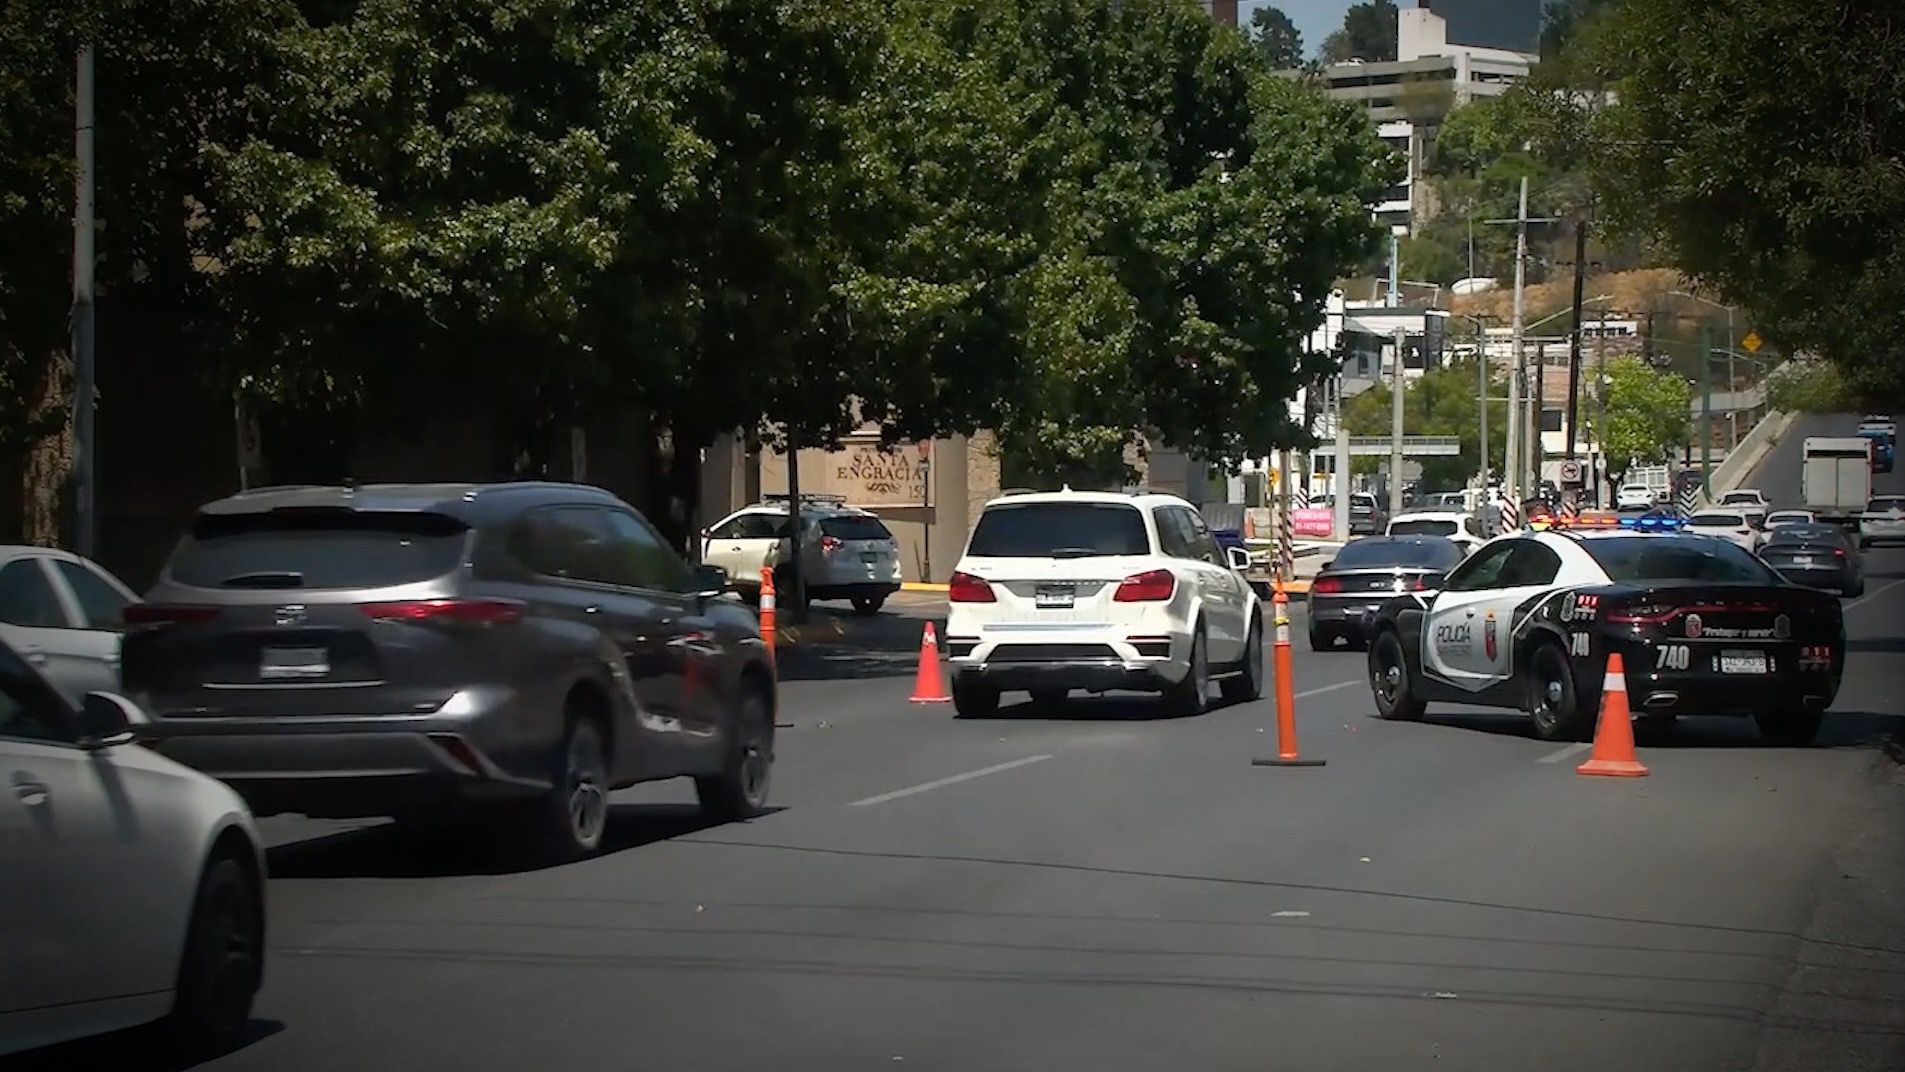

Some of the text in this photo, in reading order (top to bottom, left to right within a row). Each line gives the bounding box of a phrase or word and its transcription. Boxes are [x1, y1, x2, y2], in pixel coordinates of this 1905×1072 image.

[853, 454, 909, 467] SANTA
[838, 467, 921, 480] ENGRACIA
[1571, 632, 1590, 657] 740
[1656, 646, 1690, 669] 740
